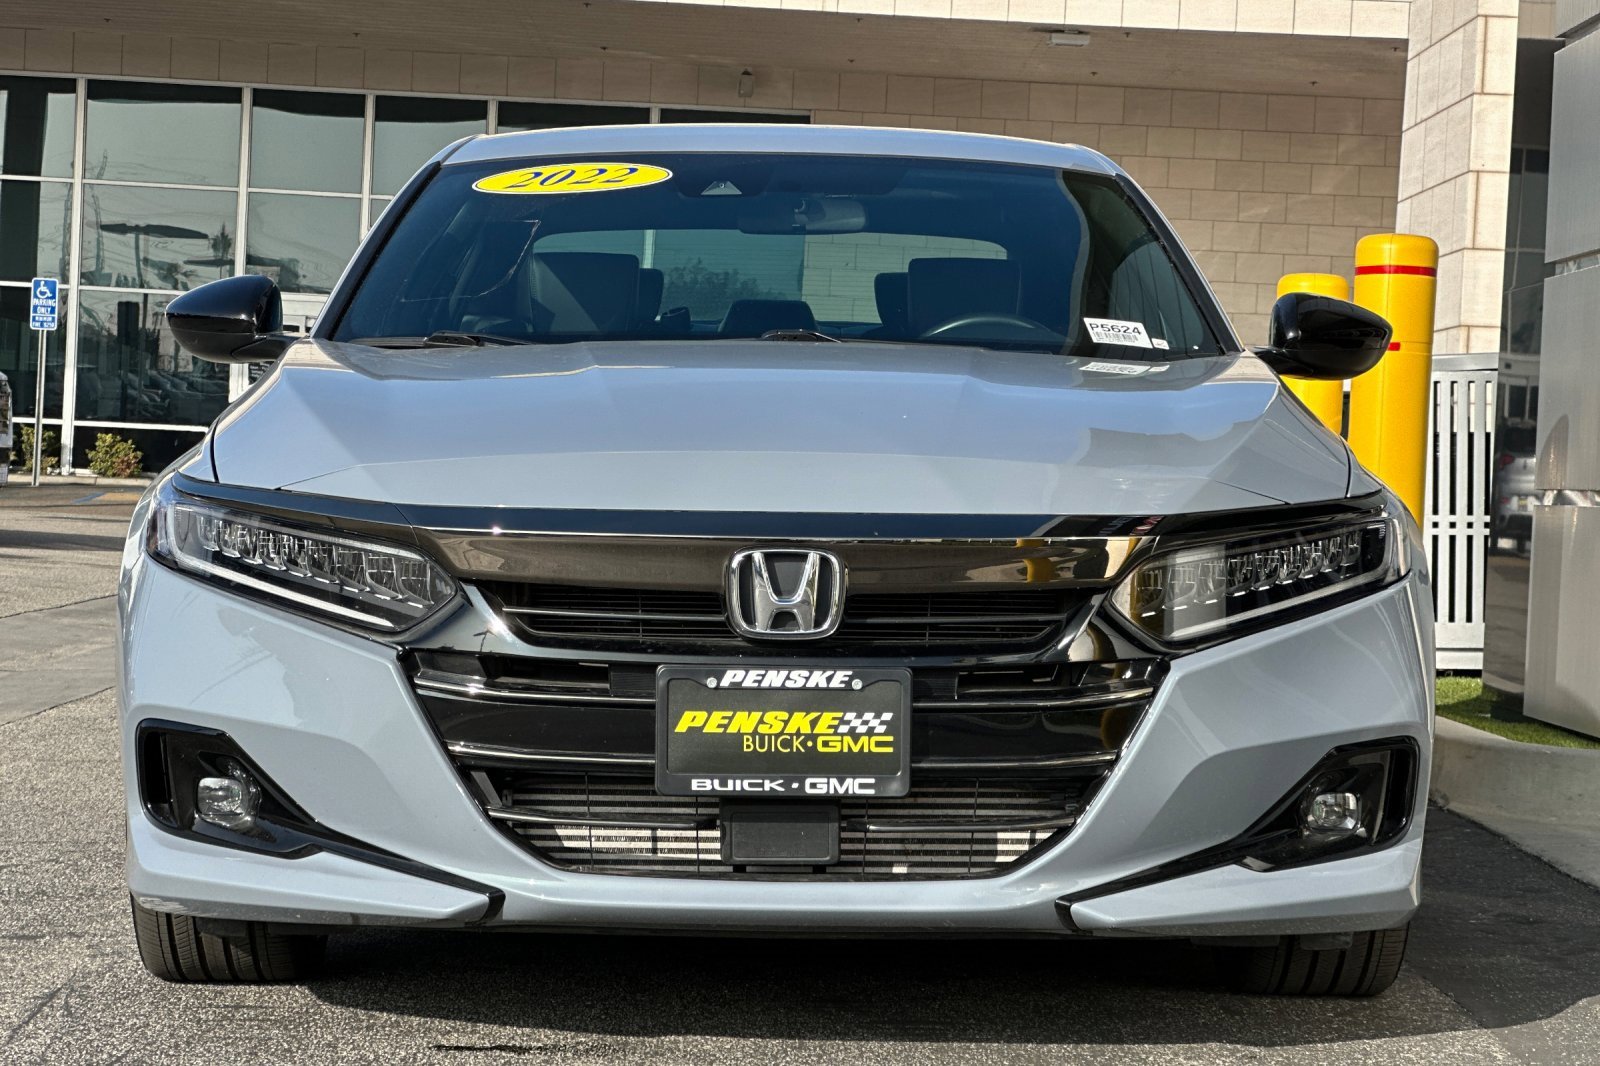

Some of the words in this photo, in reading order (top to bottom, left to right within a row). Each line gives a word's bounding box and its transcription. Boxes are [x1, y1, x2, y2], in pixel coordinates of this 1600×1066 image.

[503, 167, 639, 189] 2022
[33, 298, 56, 307] PARKING
[37, 306, 51, 314] ONLY
[1089, 322, 1142, 335] P5624
[719, 669, 853, 688] PENSKE
[674, 710, 844, 734] PENSKE
[816, 735, 894, 753] GMC
[691, 778, 785, 792] BUICK
[805, 777, 876, 795] GMC
